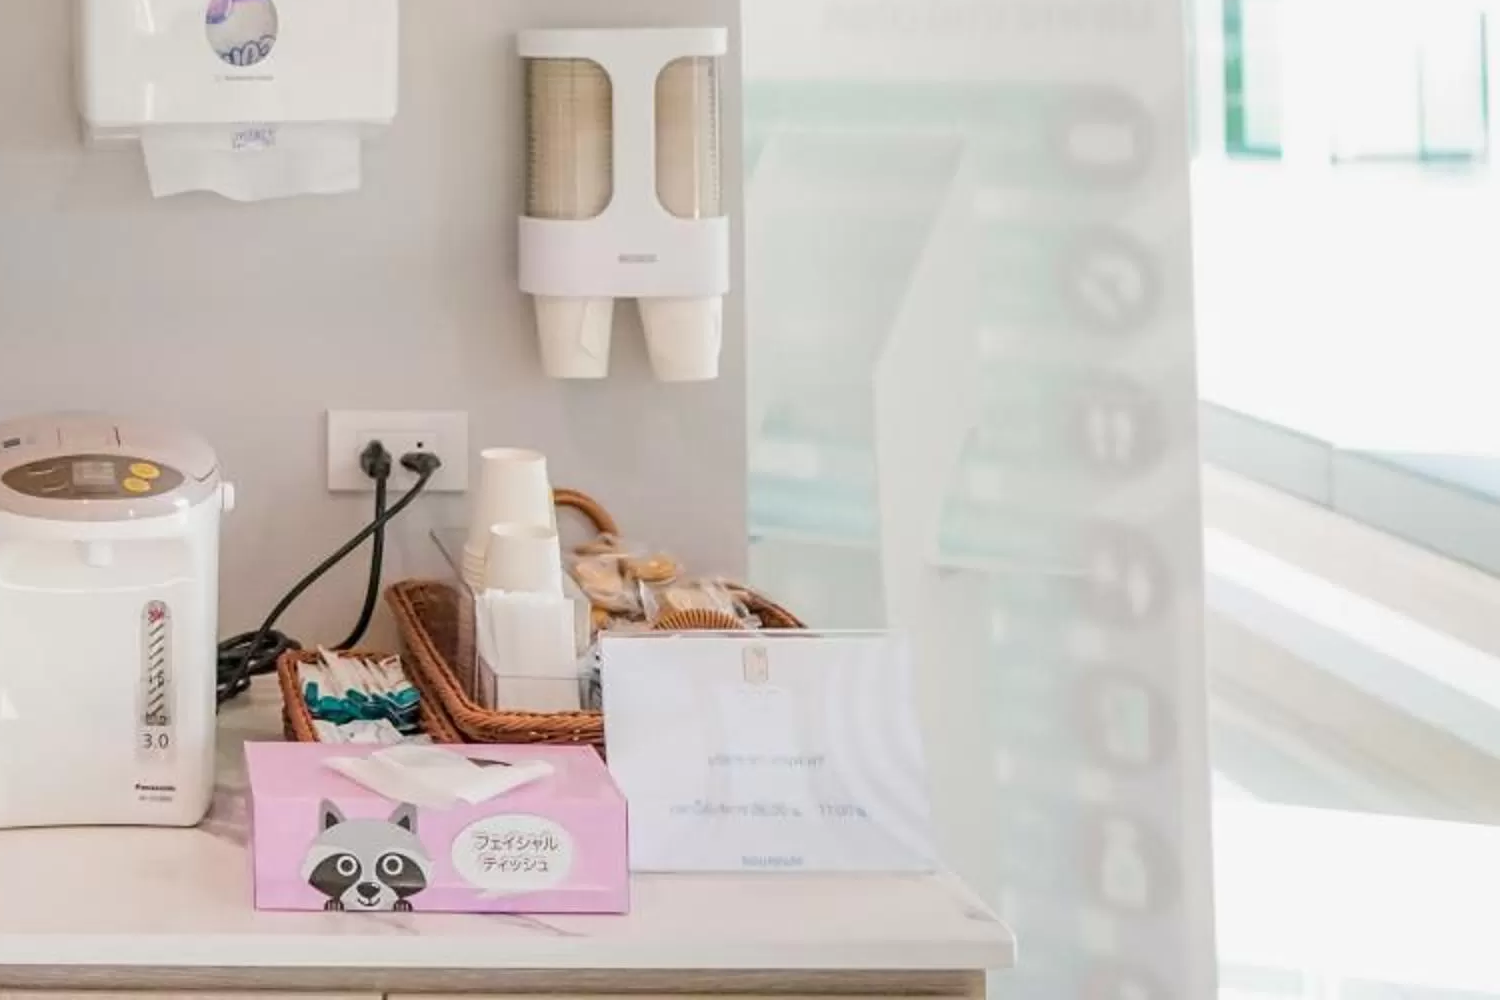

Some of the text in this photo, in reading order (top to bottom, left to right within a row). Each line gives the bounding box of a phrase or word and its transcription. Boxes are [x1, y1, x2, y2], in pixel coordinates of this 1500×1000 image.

[144, 733, 169, 749] 3.0
[475, 833, 559, 852] フェイシャル
[482, 857, 550, 873] ティッシュ
